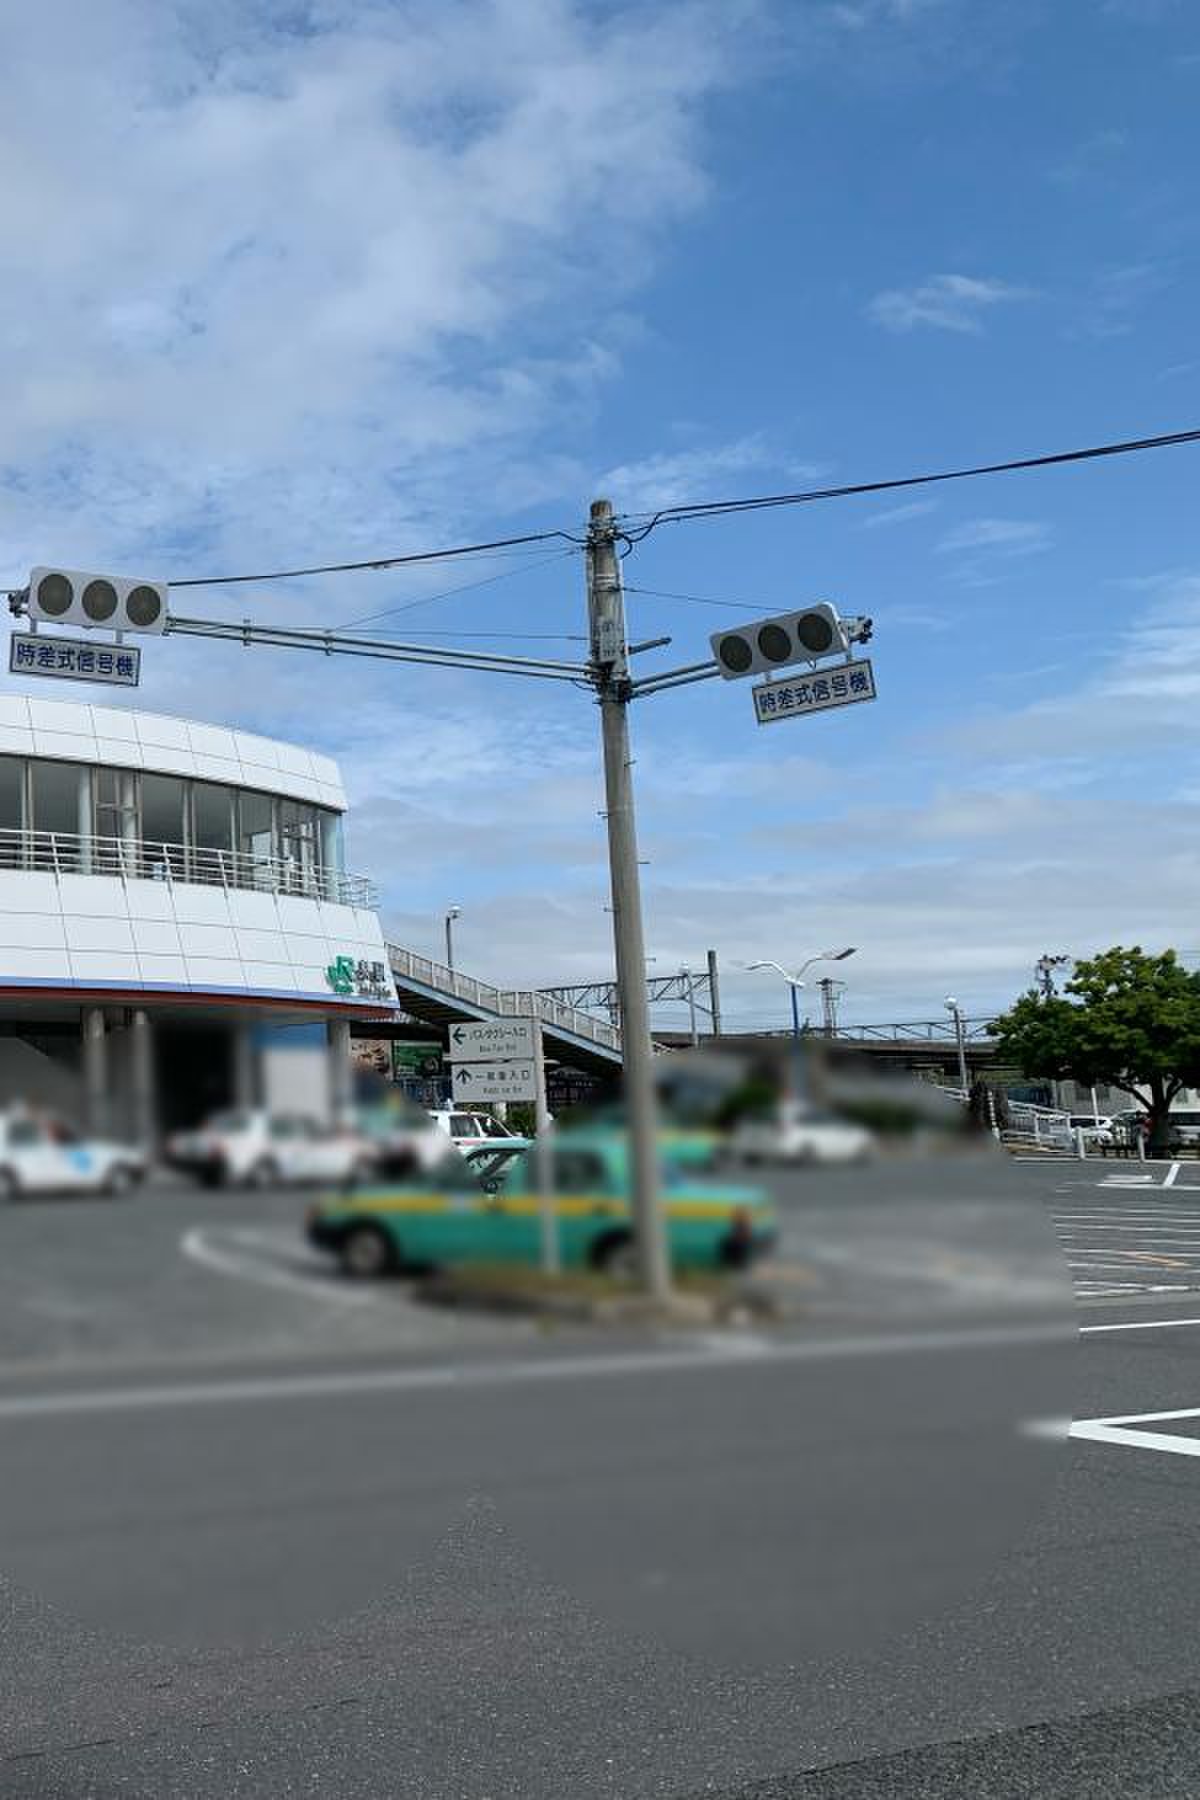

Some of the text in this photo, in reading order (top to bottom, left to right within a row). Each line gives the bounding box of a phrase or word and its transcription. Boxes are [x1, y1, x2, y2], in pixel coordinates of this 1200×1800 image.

[17, 643, 135, 678] 時差式信号機
[760, 670, 868, 712] 時差式信号機
